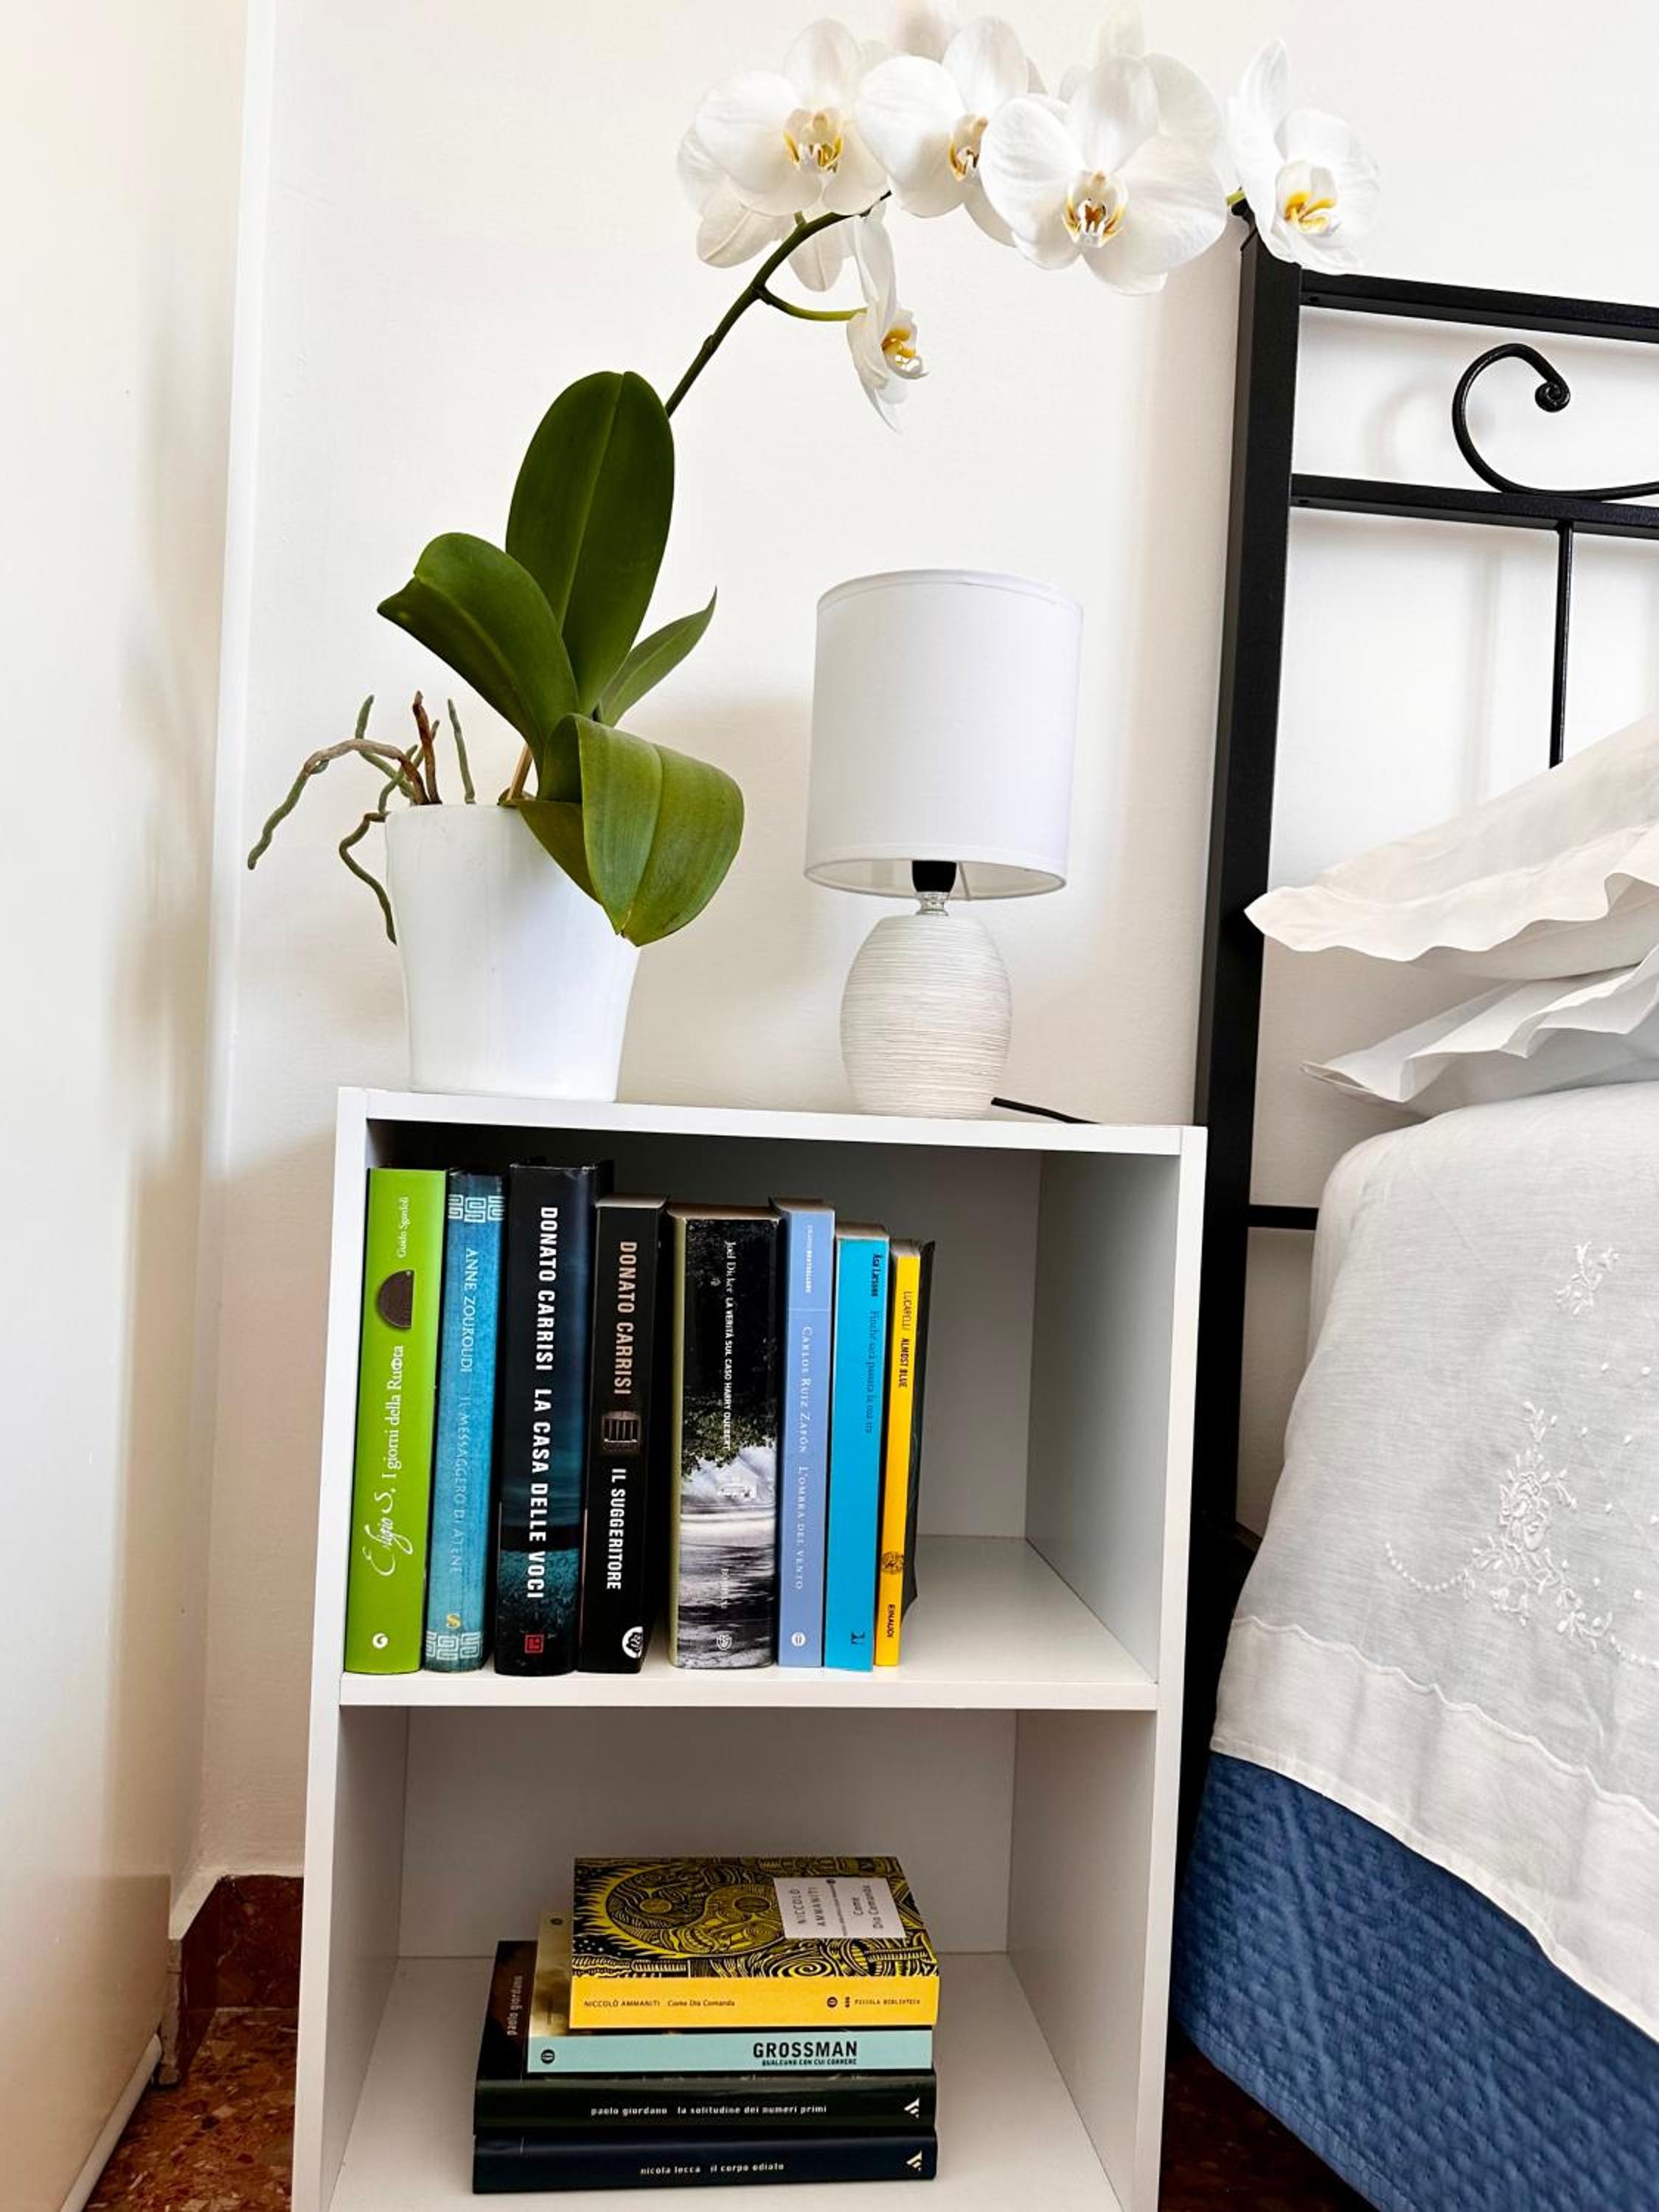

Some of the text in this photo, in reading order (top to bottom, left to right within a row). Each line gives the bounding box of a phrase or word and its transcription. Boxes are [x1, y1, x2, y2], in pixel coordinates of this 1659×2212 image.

[396, 1231, 407, 1259] Guido
[726, 1262, 737, 1293] Dicker
[459, 1248, 479, 1373] ANNE ZOUROUDI
[725, 1297, 734, 1309] LA
[613, 1241, 638, 1395] DONATO CARRISI
[724, 1340, 734, 1357] SUL
[900, 1338, 911, 1368] ALMOST
[724, 1359, 733, 1381] CASO
[898, 1369, 908, 1389] BLUE
[384, 1394, 401, 1426] della
[526, 1206, 558, 1599] DONATO CARRISI LA CASA DELLE VOCI
[723, 1382, 733, 1411] HARRY
[382, 1430, 402, 1470] giorni
[453, 1413, 472, 1504] MESSAGGERO
[374, 1488, 397, 1514] S.
[453, 1509, 466, 1523] DI
[606, 1468, 627, 1590] IL SUGGERITORE
[796, 1523, 806, 1546] DEL
[450, 1528, 464, 1574] ATENE
[795, 1550, 805, 1590] VENTO
[753, 2041, 857, 2058] GROSSMAN
[591, 2107, 619, 2116] paolo
[622, 2107, 667, 2117] giordano
[678, 2106, 686, 2114] la
[690, 2106, 741, 2115] solitudine
[744, 2105, 759, 2114] dei
[800, 2105, 827, 2115] primi
[641, 2165, 670, 2174] nicola
[720, 2164, 748, 2173] corpo
[752, 2162, 785, 2171] odiato
